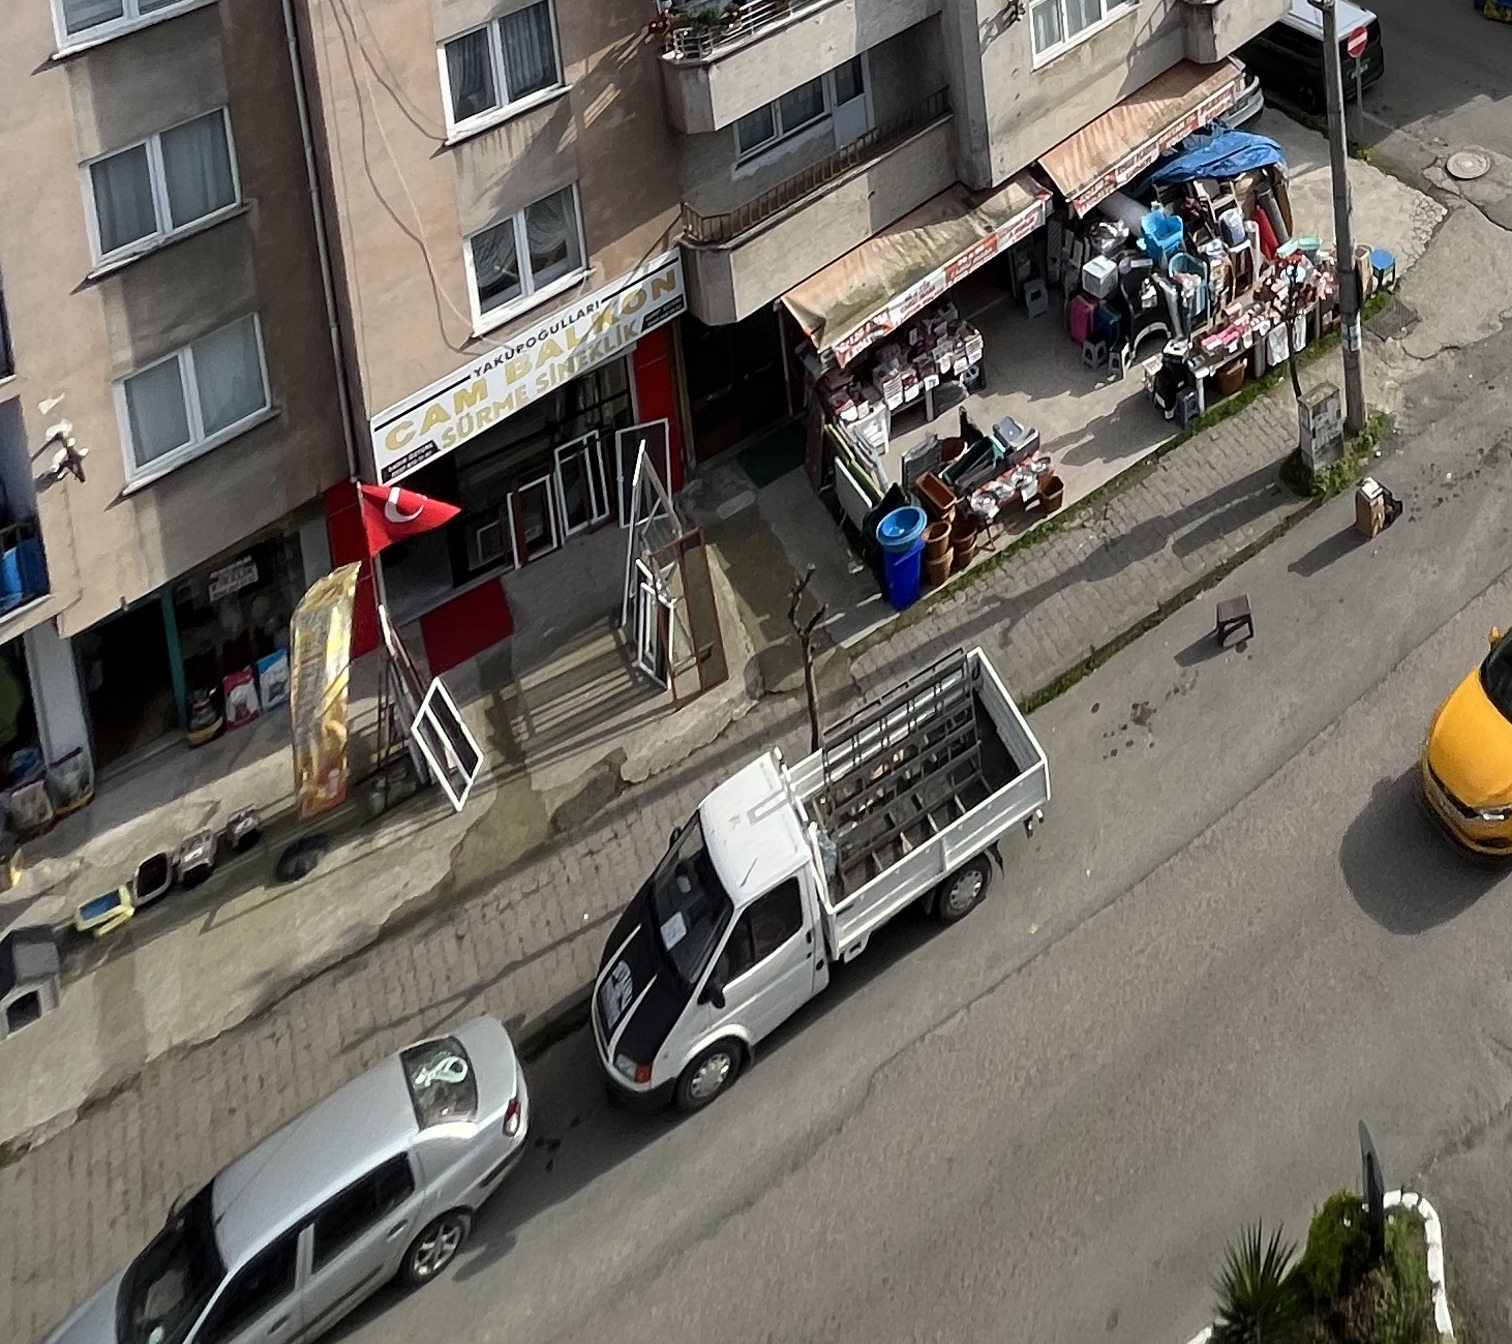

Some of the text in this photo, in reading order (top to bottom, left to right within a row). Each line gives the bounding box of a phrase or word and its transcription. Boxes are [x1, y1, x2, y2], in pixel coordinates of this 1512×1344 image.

[384, 269, 678, 452] CAM BALKON
[440, 319, 639, 450] SÜRME SİNEKLİK
[472, 300, 601, 378] YAKUPOĞULLARI
